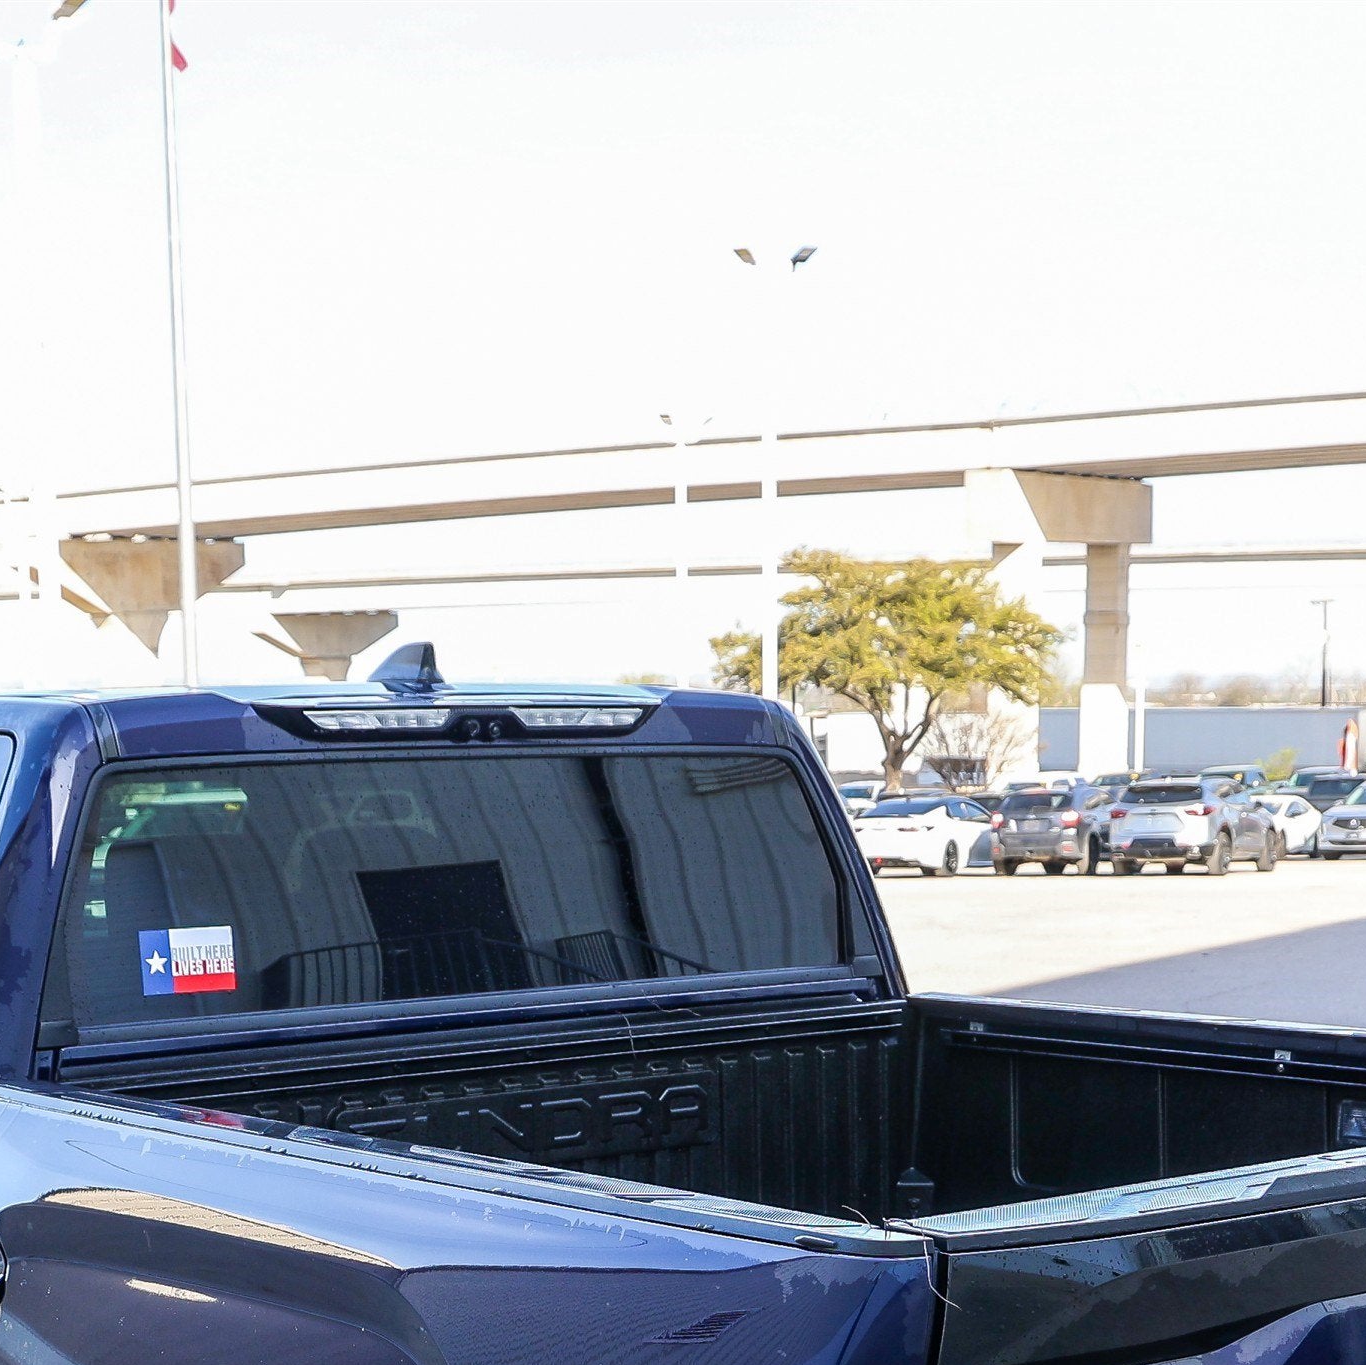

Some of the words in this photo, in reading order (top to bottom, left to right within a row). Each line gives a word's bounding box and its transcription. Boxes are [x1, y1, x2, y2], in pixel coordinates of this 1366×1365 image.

[171, 945, 203, 961] BUILT
[205, 944, 233, 959] HERE
[172, 960, 204, 976] LIVES
[206, 958, 235, 974] HERE
